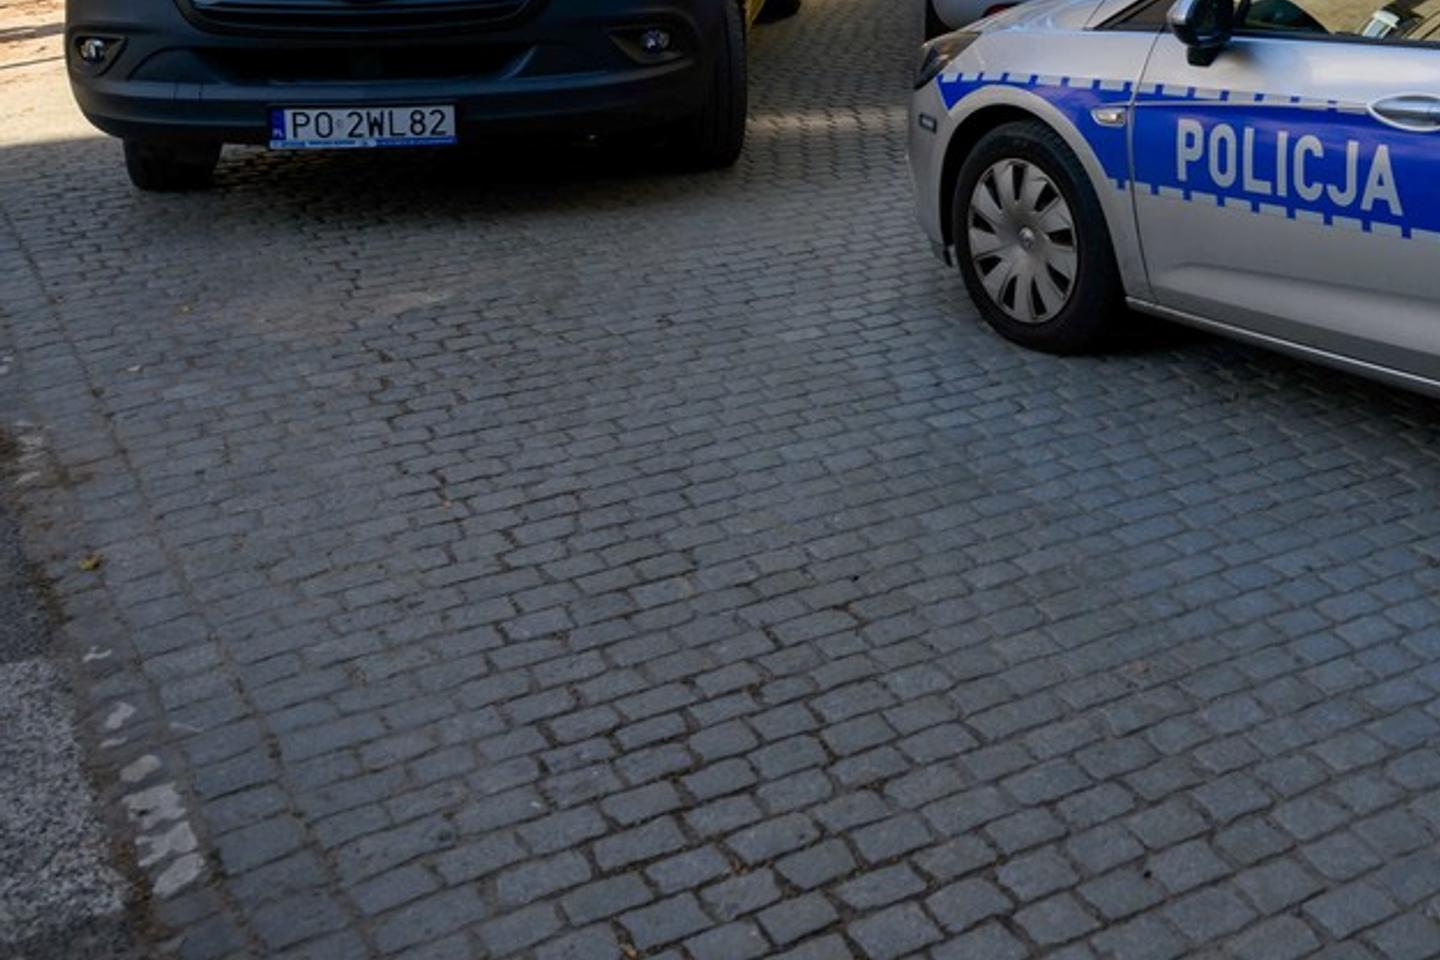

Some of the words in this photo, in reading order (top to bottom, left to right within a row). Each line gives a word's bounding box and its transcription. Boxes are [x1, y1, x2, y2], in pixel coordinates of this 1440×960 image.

[292, 111, 333, 139] PO
[347, 109, 447, 138] 2WL82
[1176, 118, 1403, 216] POLICJA
